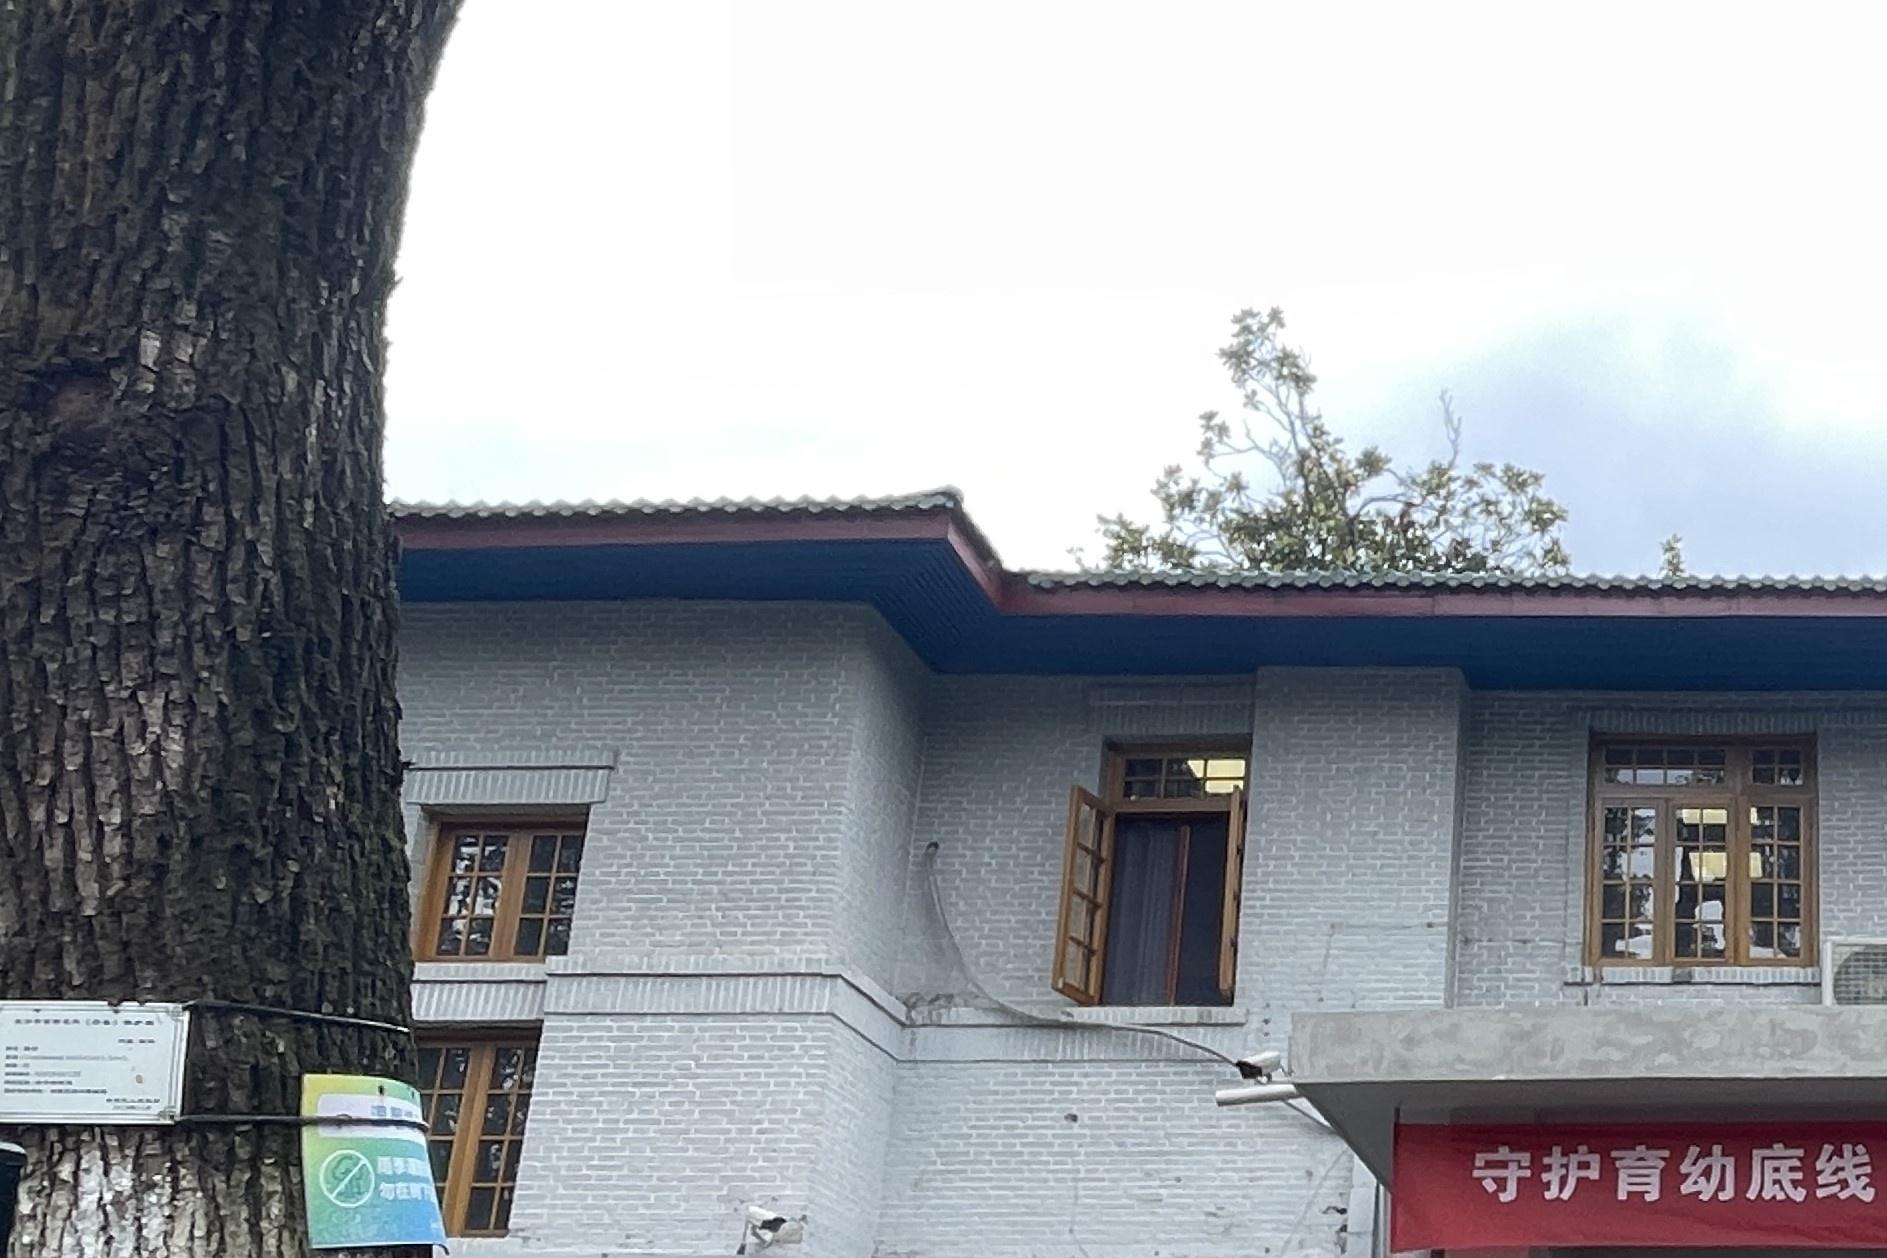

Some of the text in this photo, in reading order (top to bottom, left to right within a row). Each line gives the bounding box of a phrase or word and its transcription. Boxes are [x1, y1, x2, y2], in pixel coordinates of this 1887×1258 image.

[1471, 1142, 1876, 1203] 守护育幼底线
